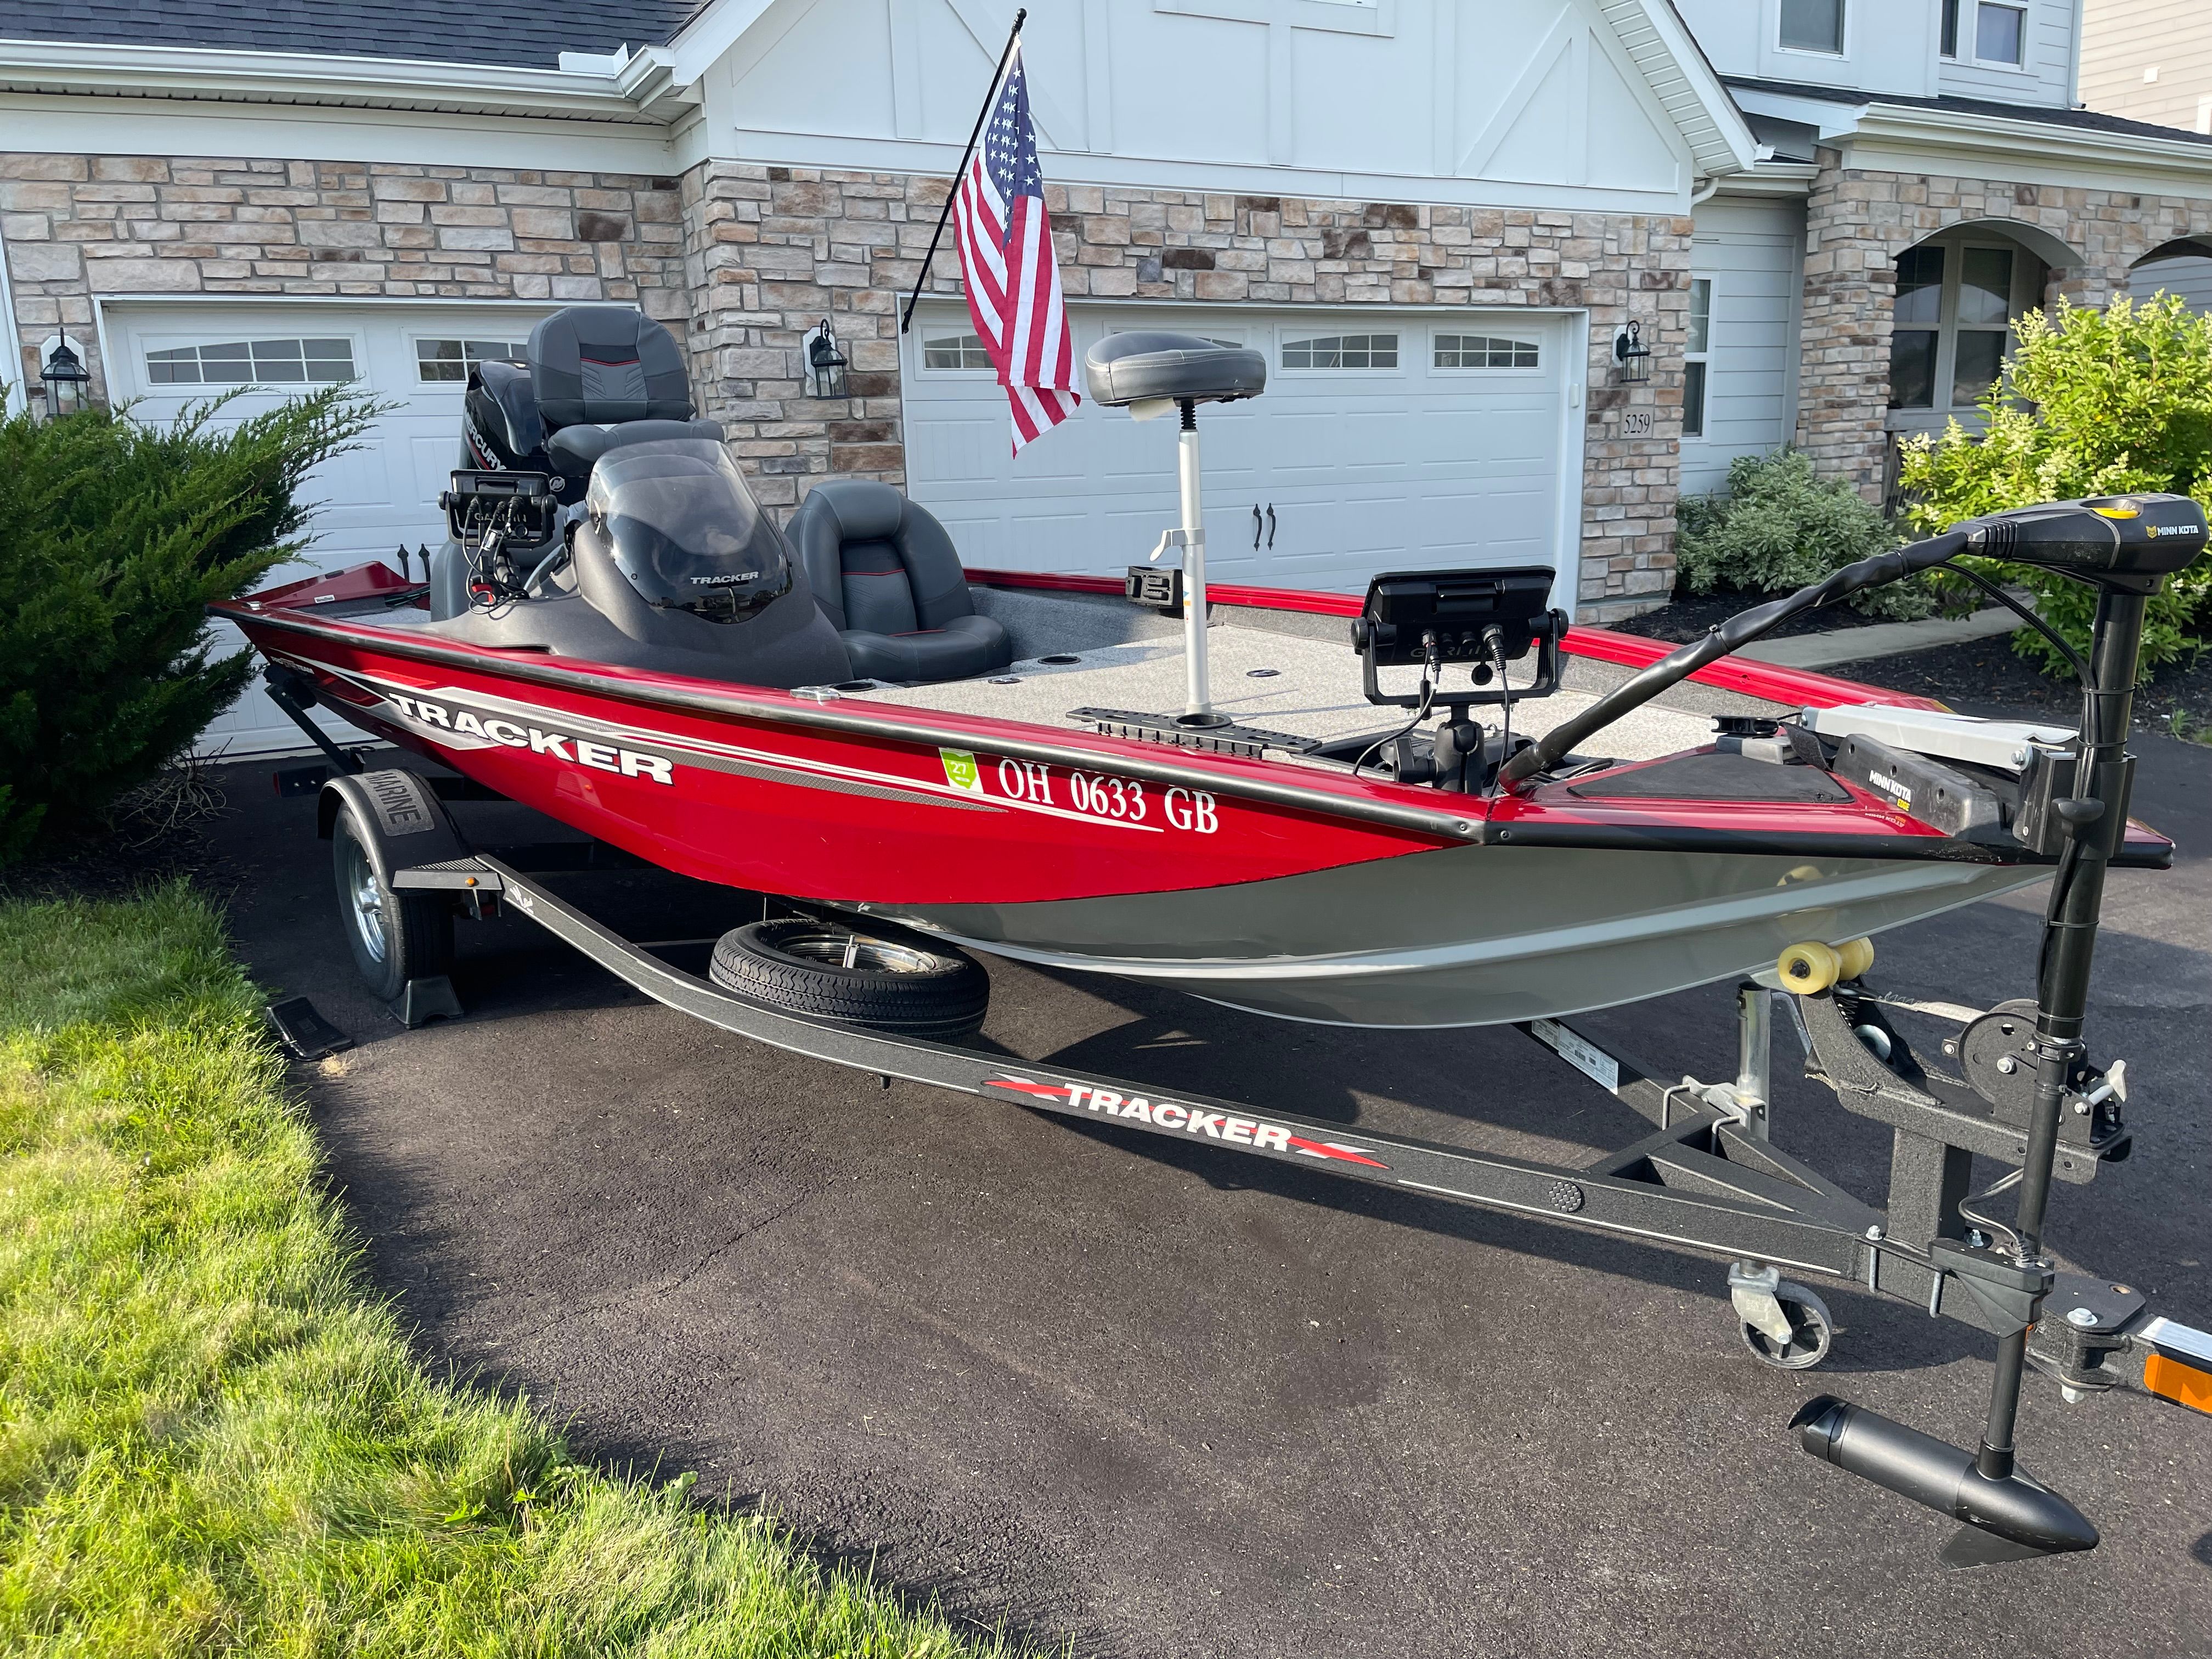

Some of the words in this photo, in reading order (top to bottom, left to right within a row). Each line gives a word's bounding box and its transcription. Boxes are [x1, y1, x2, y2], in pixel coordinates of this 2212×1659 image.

[1624, 414, 1650, 433] 5259
[2157, 526, 2177, 536] MINN
[2179, 525, 2199, 534] KOTA
[690, 571, 759, 584] TRACKER
[388, 692, 674, 786] TRACKER
[950, 761, 966, 775] 27
[364, 772, 421, 824] MARINE
[998, 759, 1054, 804] OH
[1070, 772, 1146, 821] 0633
[1164, 787, 1218, 834] GB
[1869, 770, 1891, 791] MINN
[1891, 779, 1911, 802] KOTA
[1064, 1083, 1292, 1152] TRACKER
